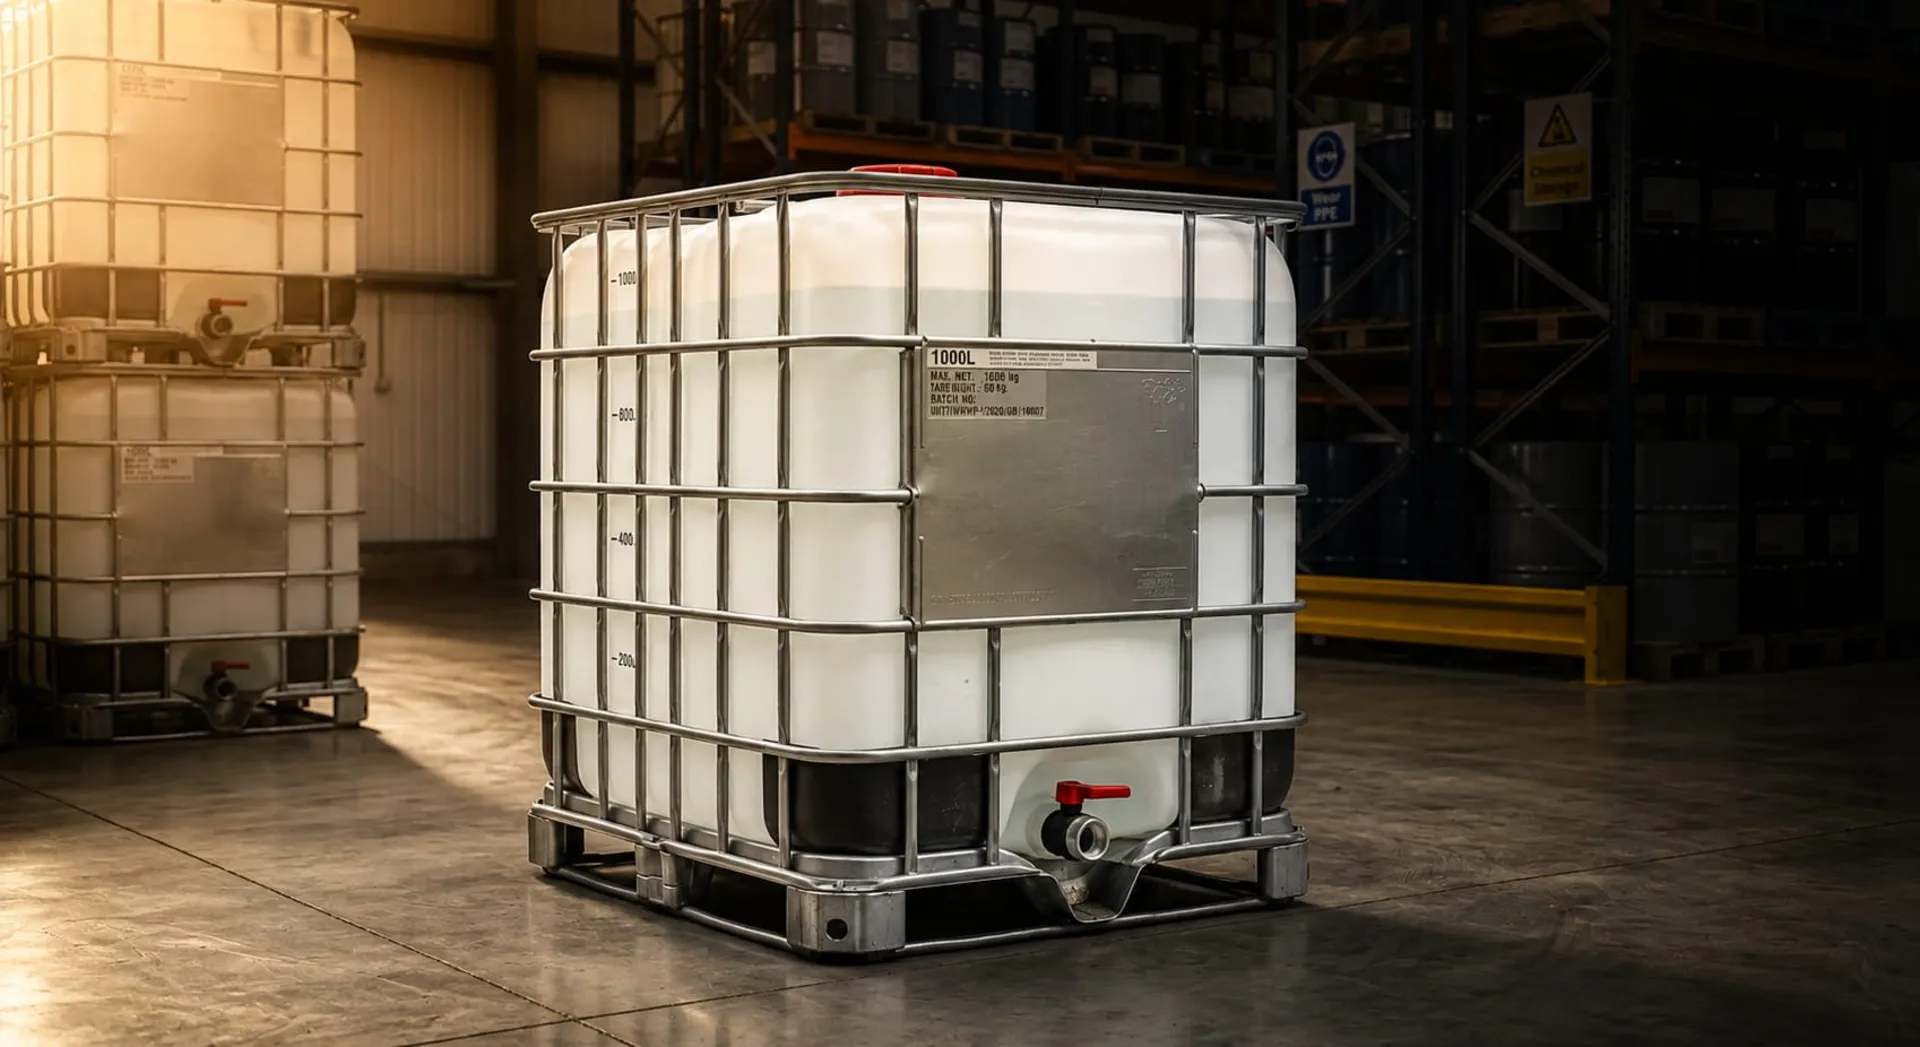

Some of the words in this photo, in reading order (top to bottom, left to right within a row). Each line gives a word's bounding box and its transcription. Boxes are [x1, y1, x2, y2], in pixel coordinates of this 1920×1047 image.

[1313, 206, 1339, 222] PPE
[931, 349, 976, 365] 1000L
[931, 394, 959, 404] BATCH
[619, 532, 634, 546] 400
